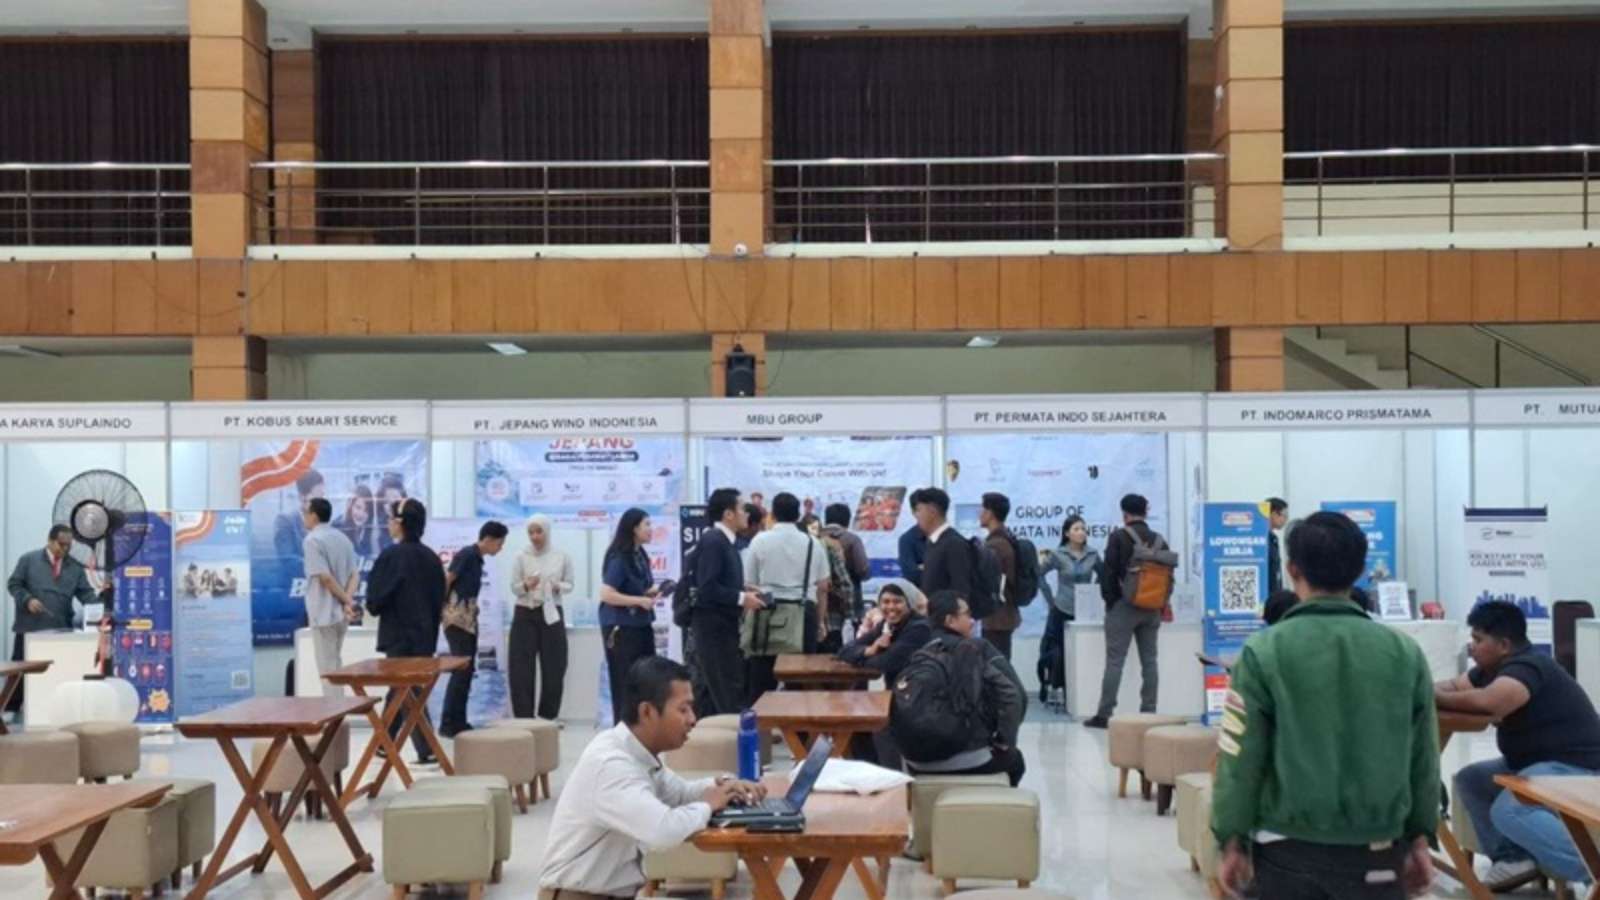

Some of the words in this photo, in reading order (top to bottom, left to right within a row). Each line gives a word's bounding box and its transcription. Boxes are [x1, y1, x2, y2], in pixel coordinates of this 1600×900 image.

[246, 415, 292, 428] KOBUS
[295, 415, 339, 427] SMART
[343, 414, 397, 427] SERVICE
[747, 413, 775, 425] MBU
[777, 412, 823, 425] GROUP
[995, 411, 1055, 423] PERMATA
[1057, 411, 1088, 423] INDO
[1091, 410, 1167, 423] SEJAHTERA
[1263, 409, 1343, 421] INDOMARCO
[1346, 408, 1432, 420] PRISMATAMA
[11, 417, 55, 429] KARYA
[57, 416, 132, 430] SUPLAINDO
[499, 418, 549, 431] JEPANG
[589, 416, 657, 428] INDONESIA
[1015, 505, 1062, 519] GROUP
[1066, 505, 1085, 517] OF
[1007, 524, 1045, 539] MATA
